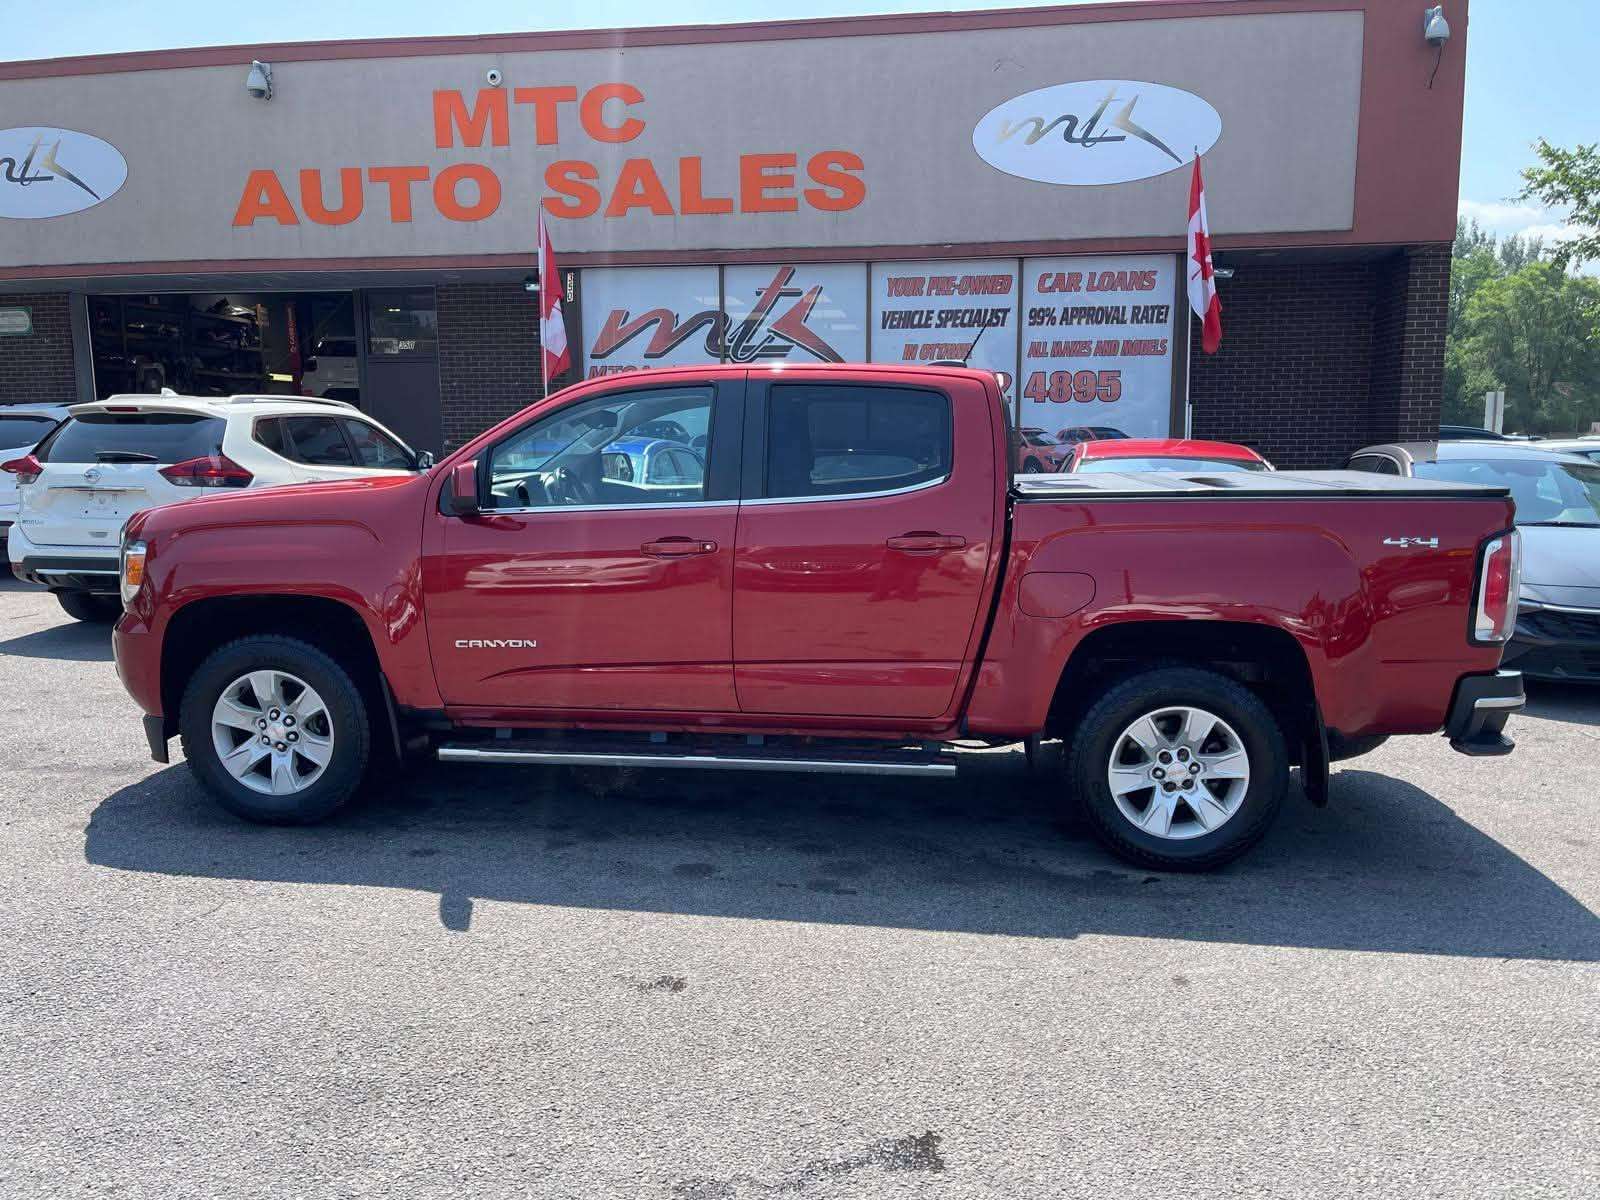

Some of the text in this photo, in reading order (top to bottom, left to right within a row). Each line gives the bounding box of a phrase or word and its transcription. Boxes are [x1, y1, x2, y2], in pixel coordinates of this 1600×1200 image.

[433, 83, 646, 149] MTC
[231, 151, 867, 227] AUTO SALES
[887, 274, 1013, 297] YOUR PRE-OWNED
[1038, 270, 1158, 294] CAR LOANS
[881, 308, 1011, 329] VEHICLE SPECIALIST
[1028, 304, 1170, 327] 99% APPROVAL RATE!
[1027, 339, 1168, 358] ALL MAKES AND MODELS
[1024, 370, 1122, 403] 4895
[455, 639, 537, 648] CANYON
